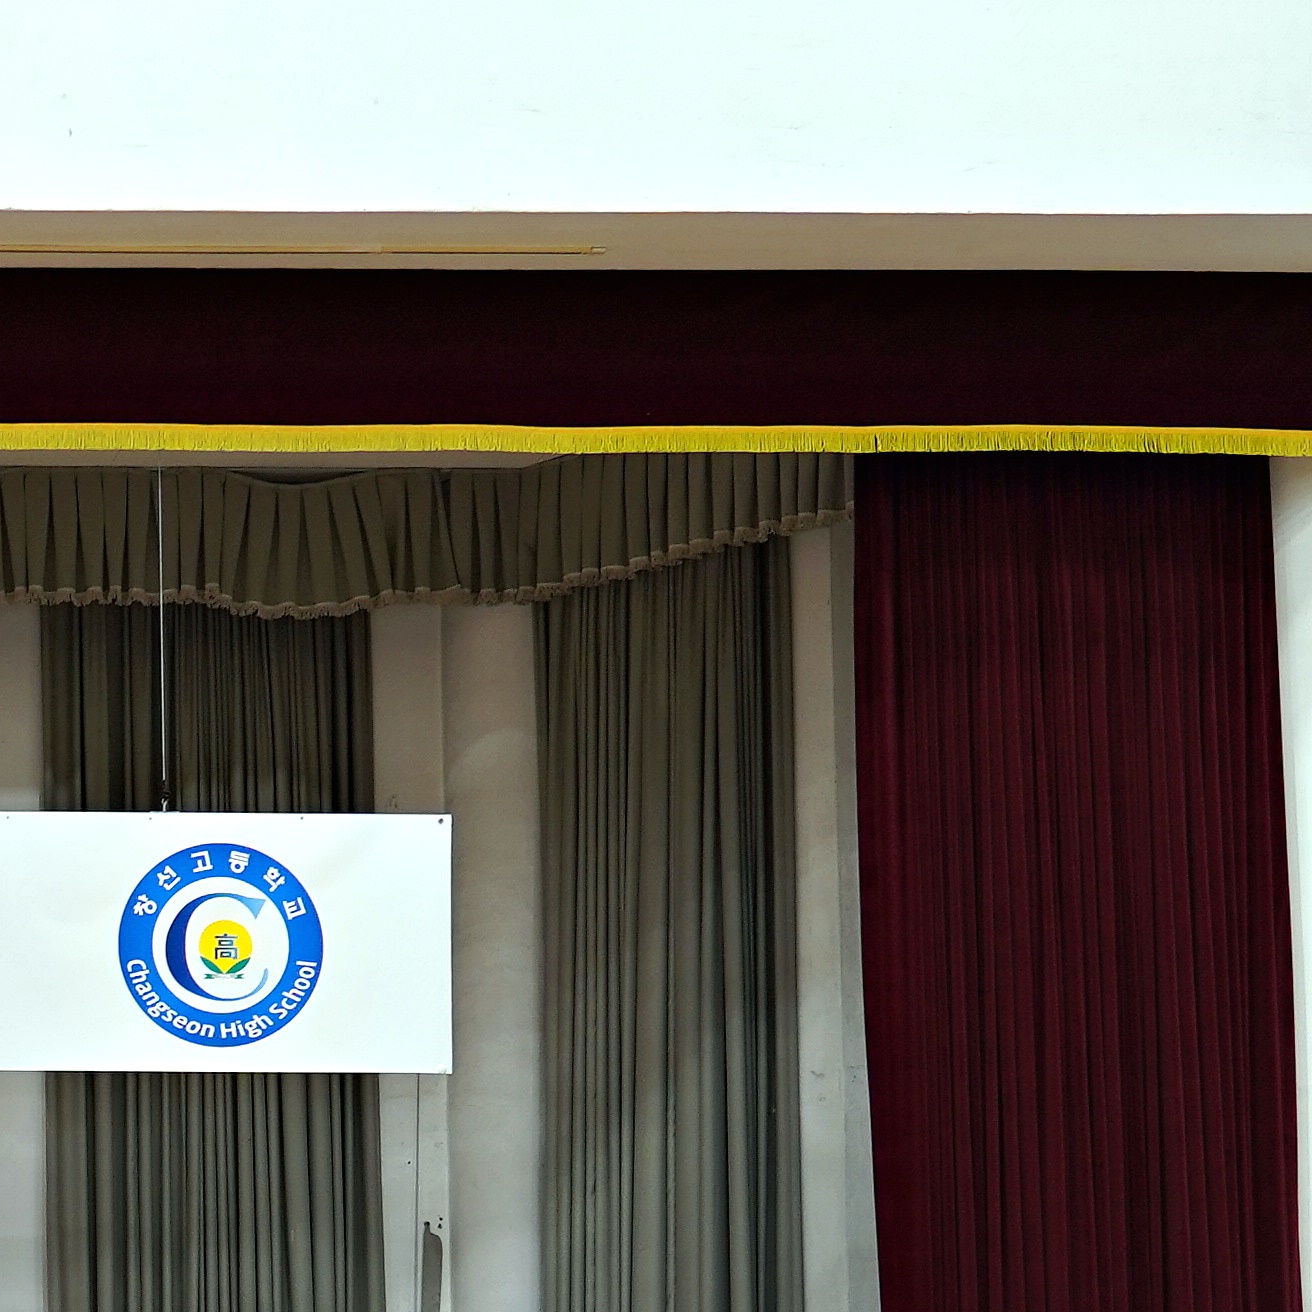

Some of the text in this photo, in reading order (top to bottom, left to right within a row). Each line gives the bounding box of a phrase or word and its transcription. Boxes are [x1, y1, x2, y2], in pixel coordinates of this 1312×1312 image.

[133, 850, 306, 920] 창선고등학교
[214, 934, 238, 960] 高
[126, 958, 317, 1039] Changseon High School
